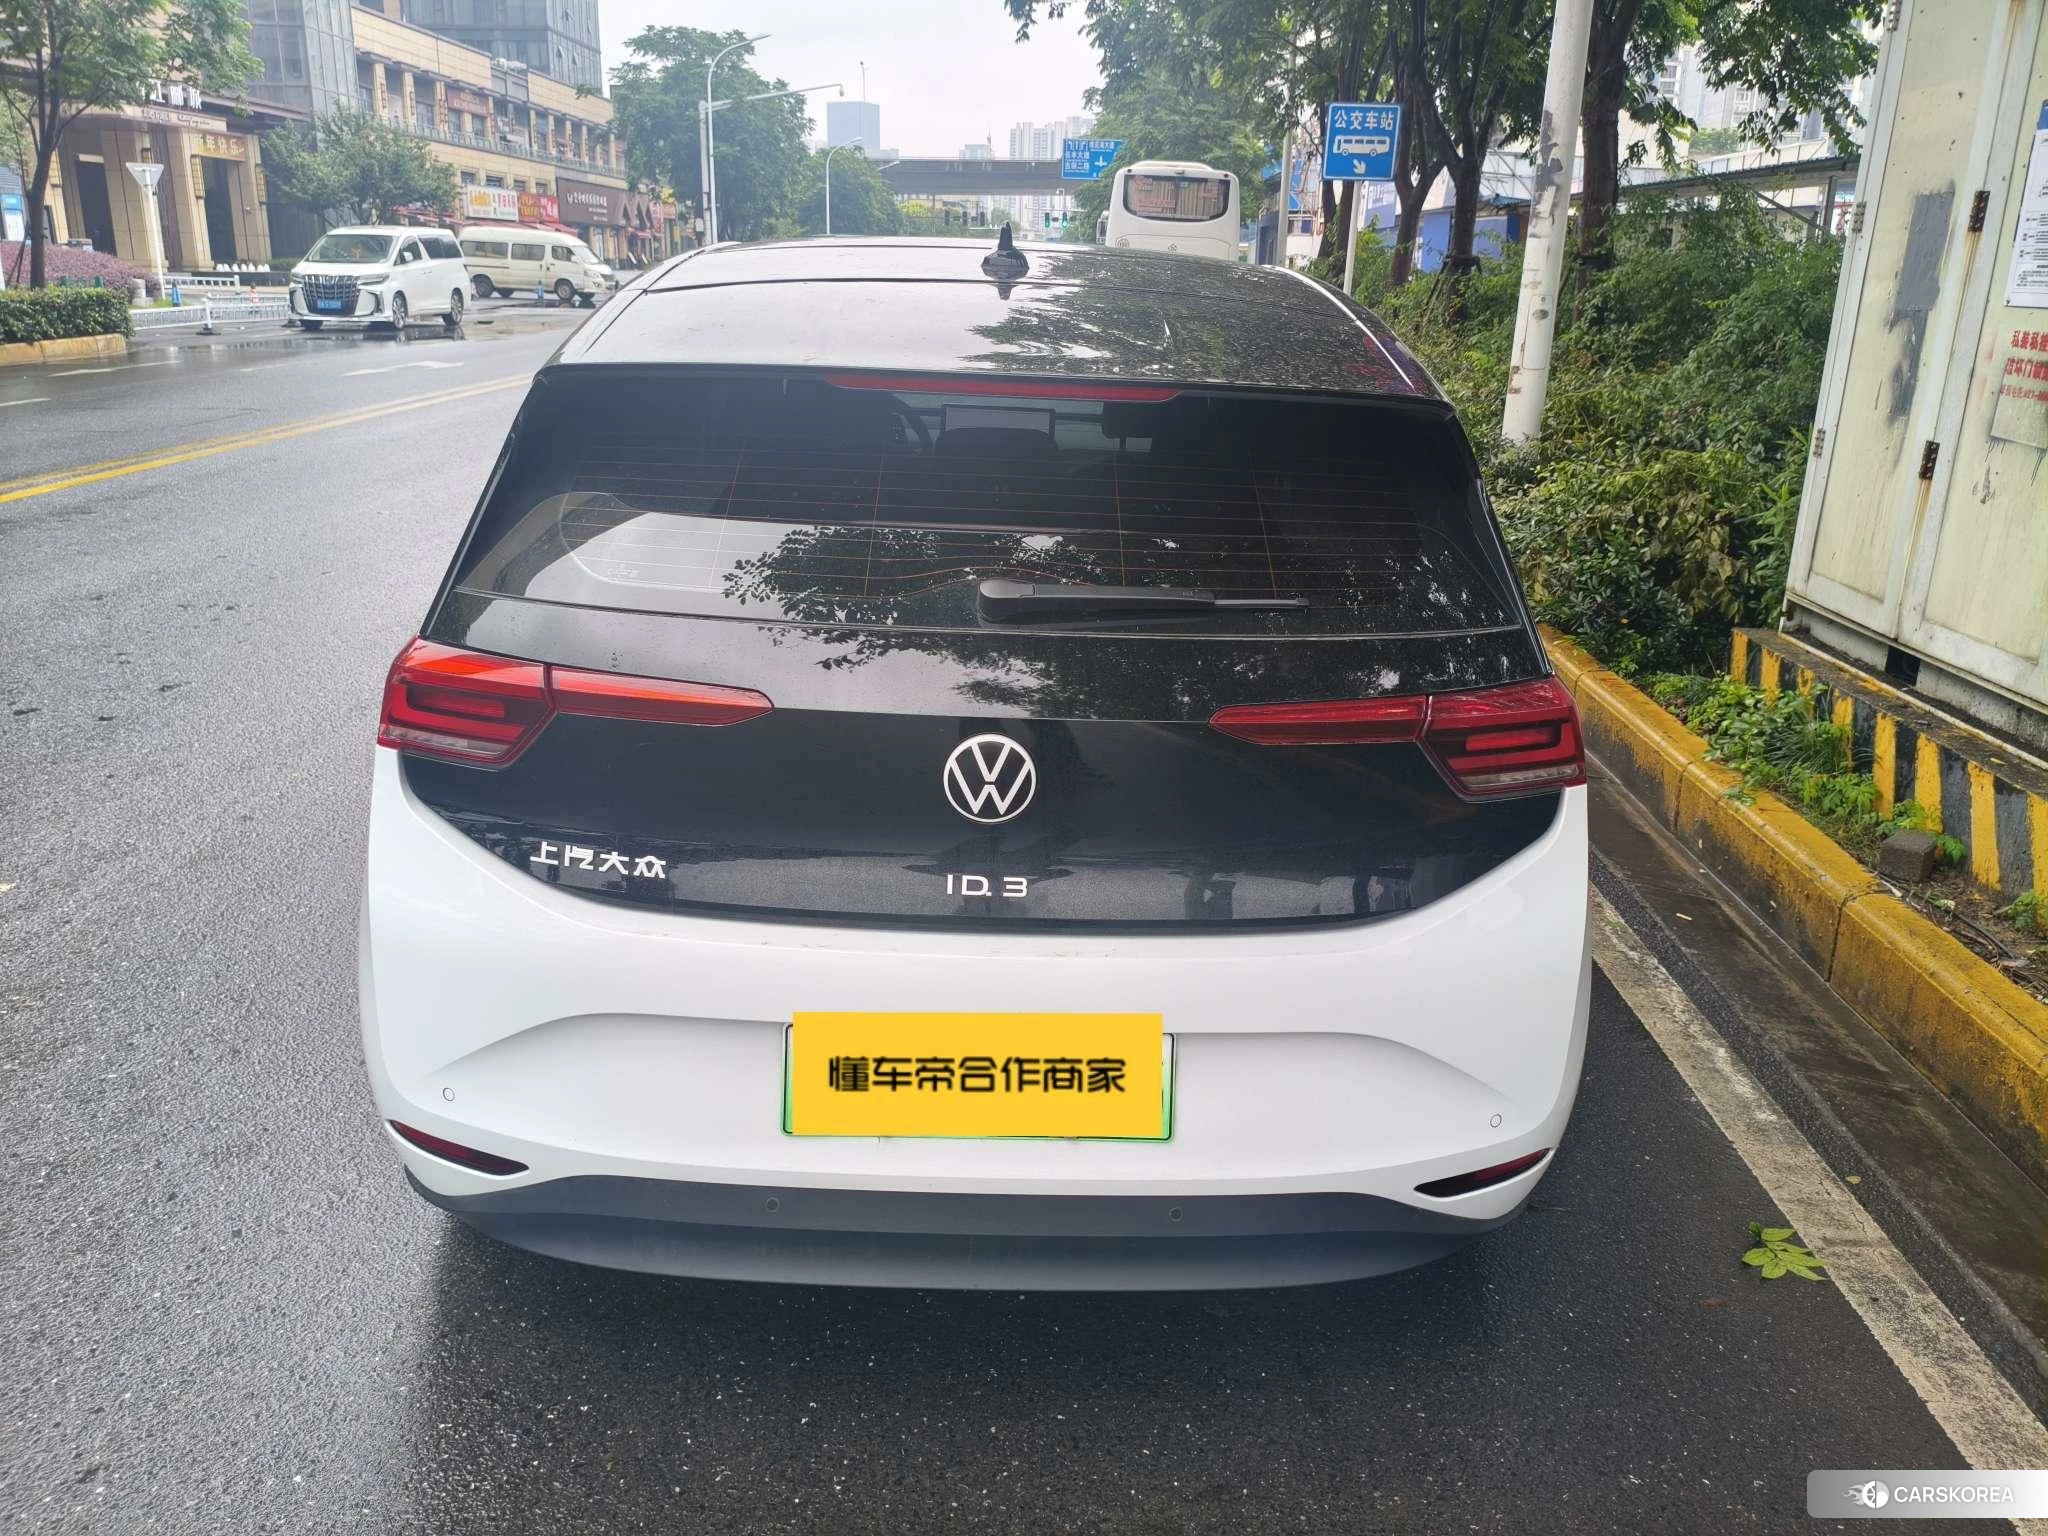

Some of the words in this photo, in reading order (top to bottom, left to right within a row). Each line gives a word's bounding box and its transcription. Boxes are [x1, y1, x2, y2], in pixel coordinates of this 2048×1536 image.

[1334, 109, 1394, 131] 公交车站
[943, 733, 1037, 823] VW
[530, 841, 666, 879] 上汽大众
